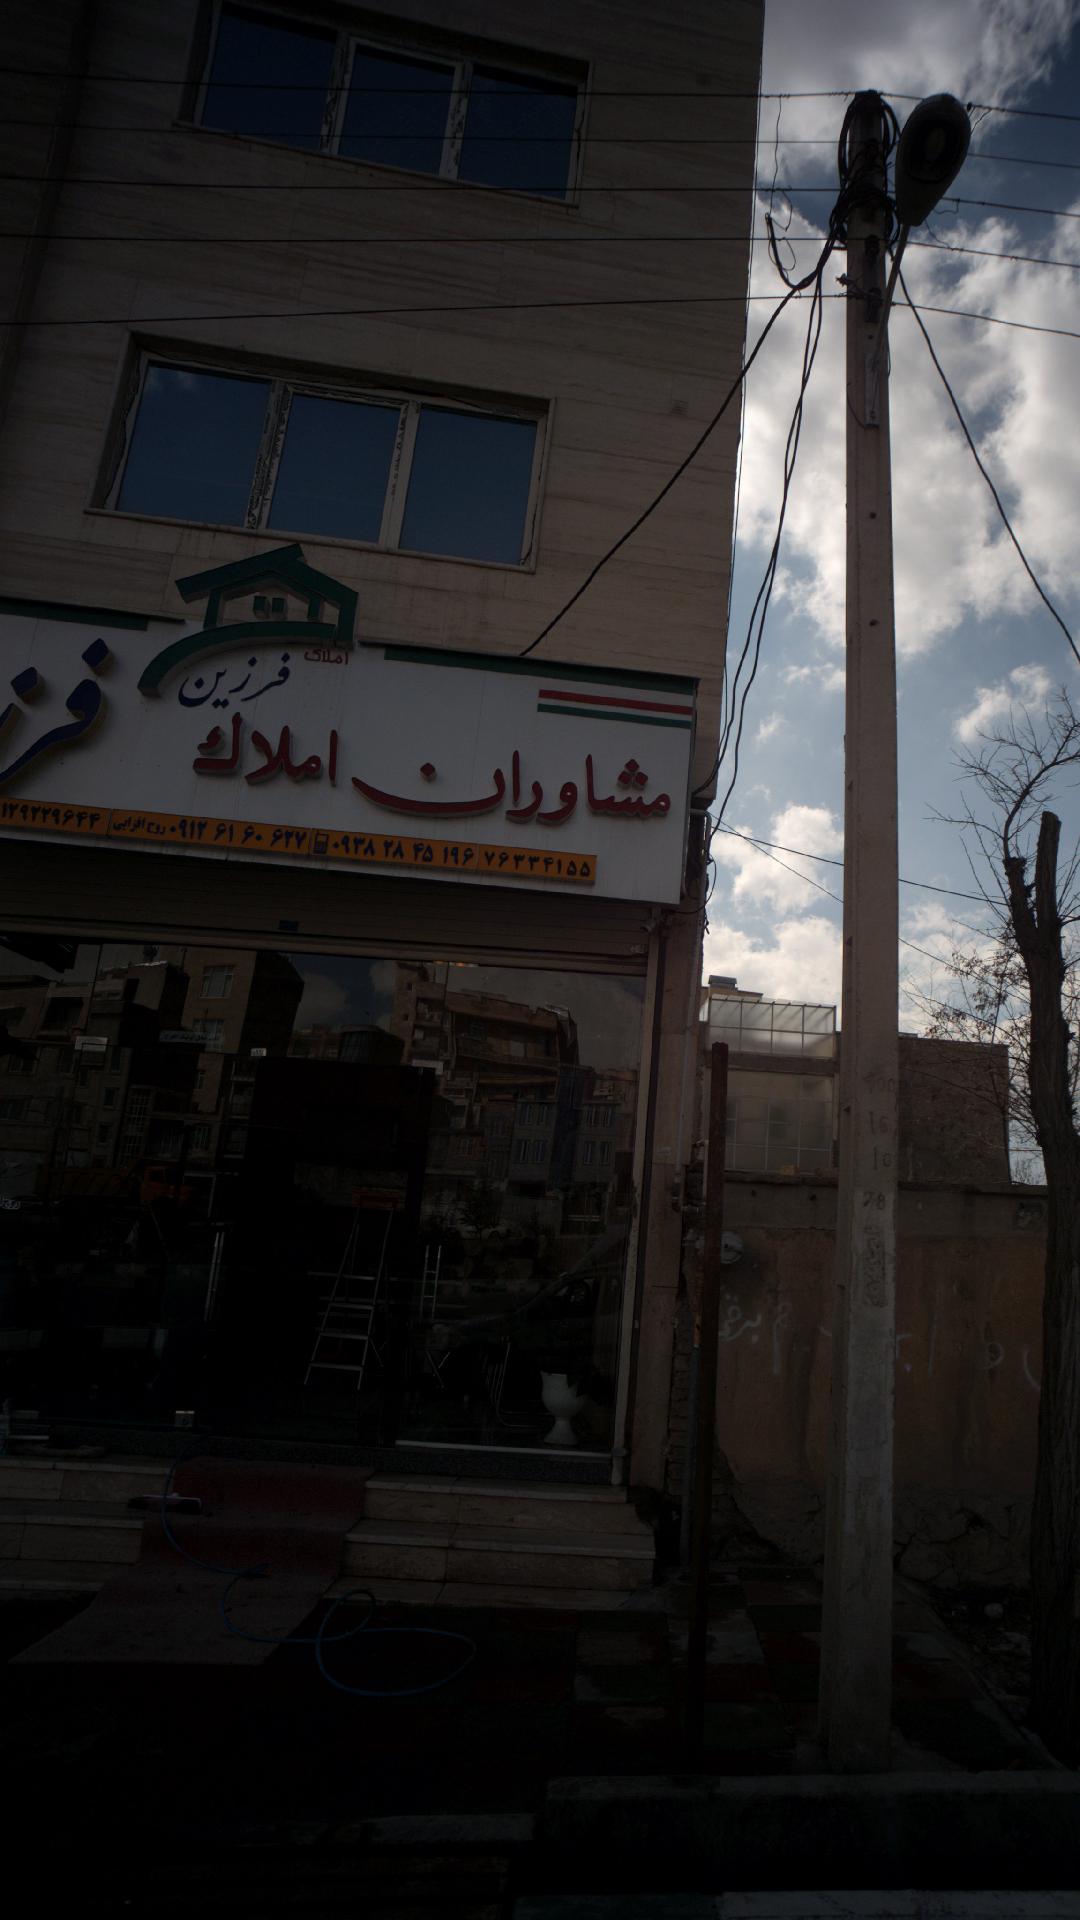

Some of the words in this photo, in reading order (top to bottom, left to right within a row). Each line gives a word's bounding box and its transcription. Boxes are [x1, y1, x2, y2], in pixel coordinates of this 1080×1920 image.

[178, 653, 290, 708] فرزین
[352, 750, 671, 825] مشاوران
[170, 819, 208, 840] ۰۹۱۲
[333, 834, 375, 857] ۰۹۳۸
[413, 842, 434, 863] ۴۵
[443, 846, 474, 866] ۱۹۶
